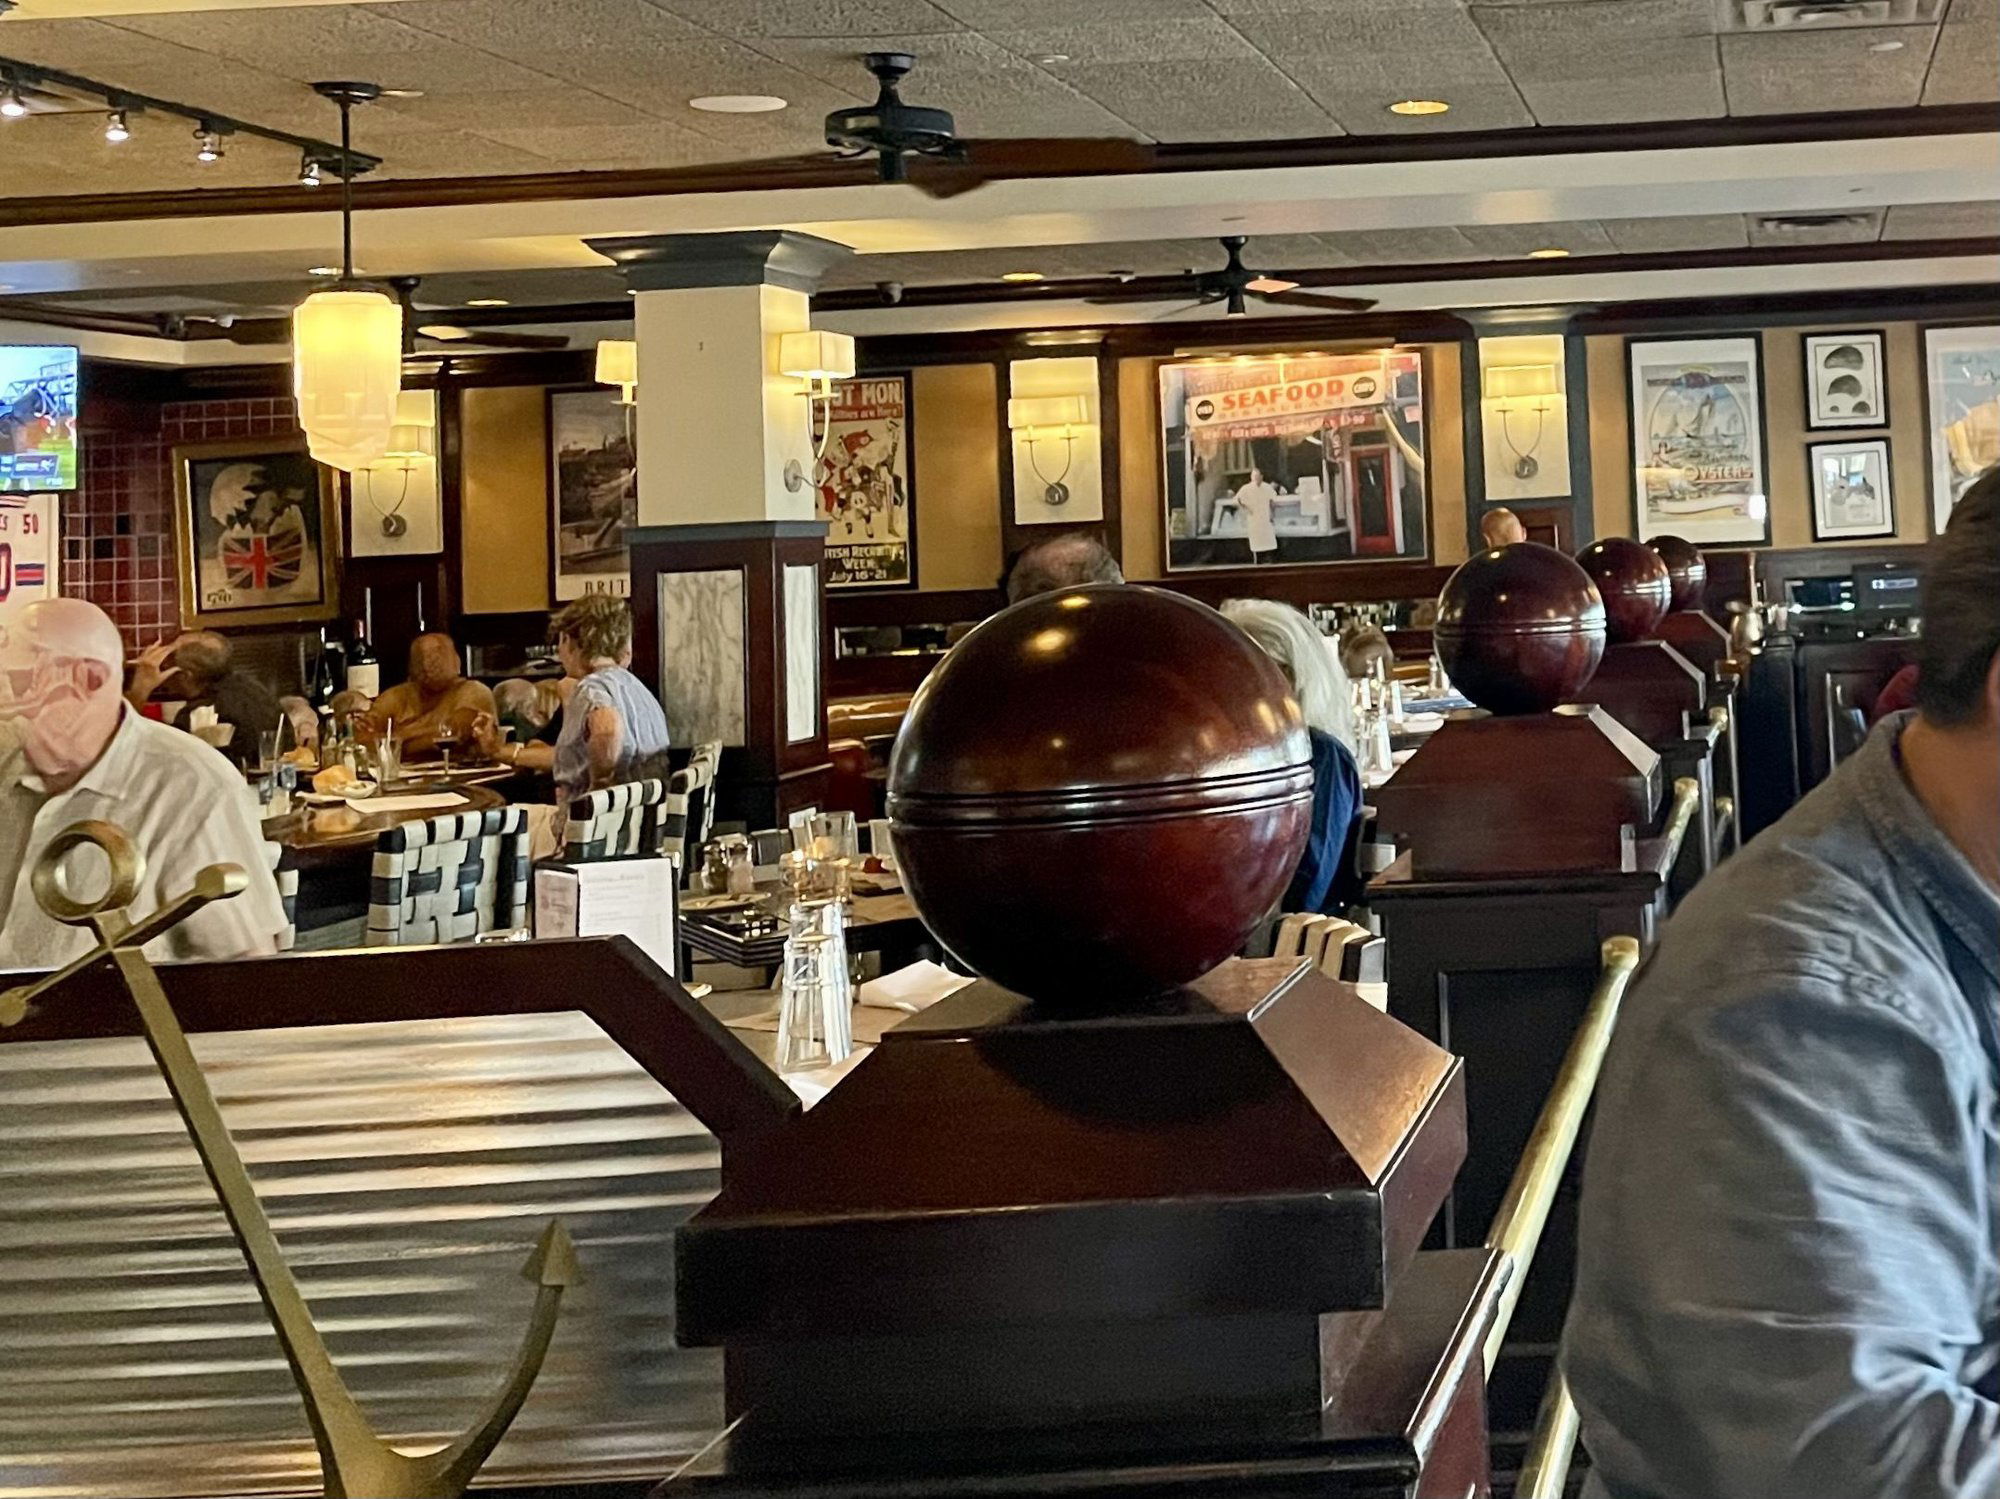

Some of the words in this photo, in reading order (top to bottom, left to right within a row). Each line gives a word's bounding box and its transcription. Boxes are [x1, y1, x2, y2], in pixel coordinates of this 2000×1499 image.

[1221, 380, 1345, 411] SEAFOOD
[22, 513, 39, 535] 50
[829, 571, 853, 585] July
